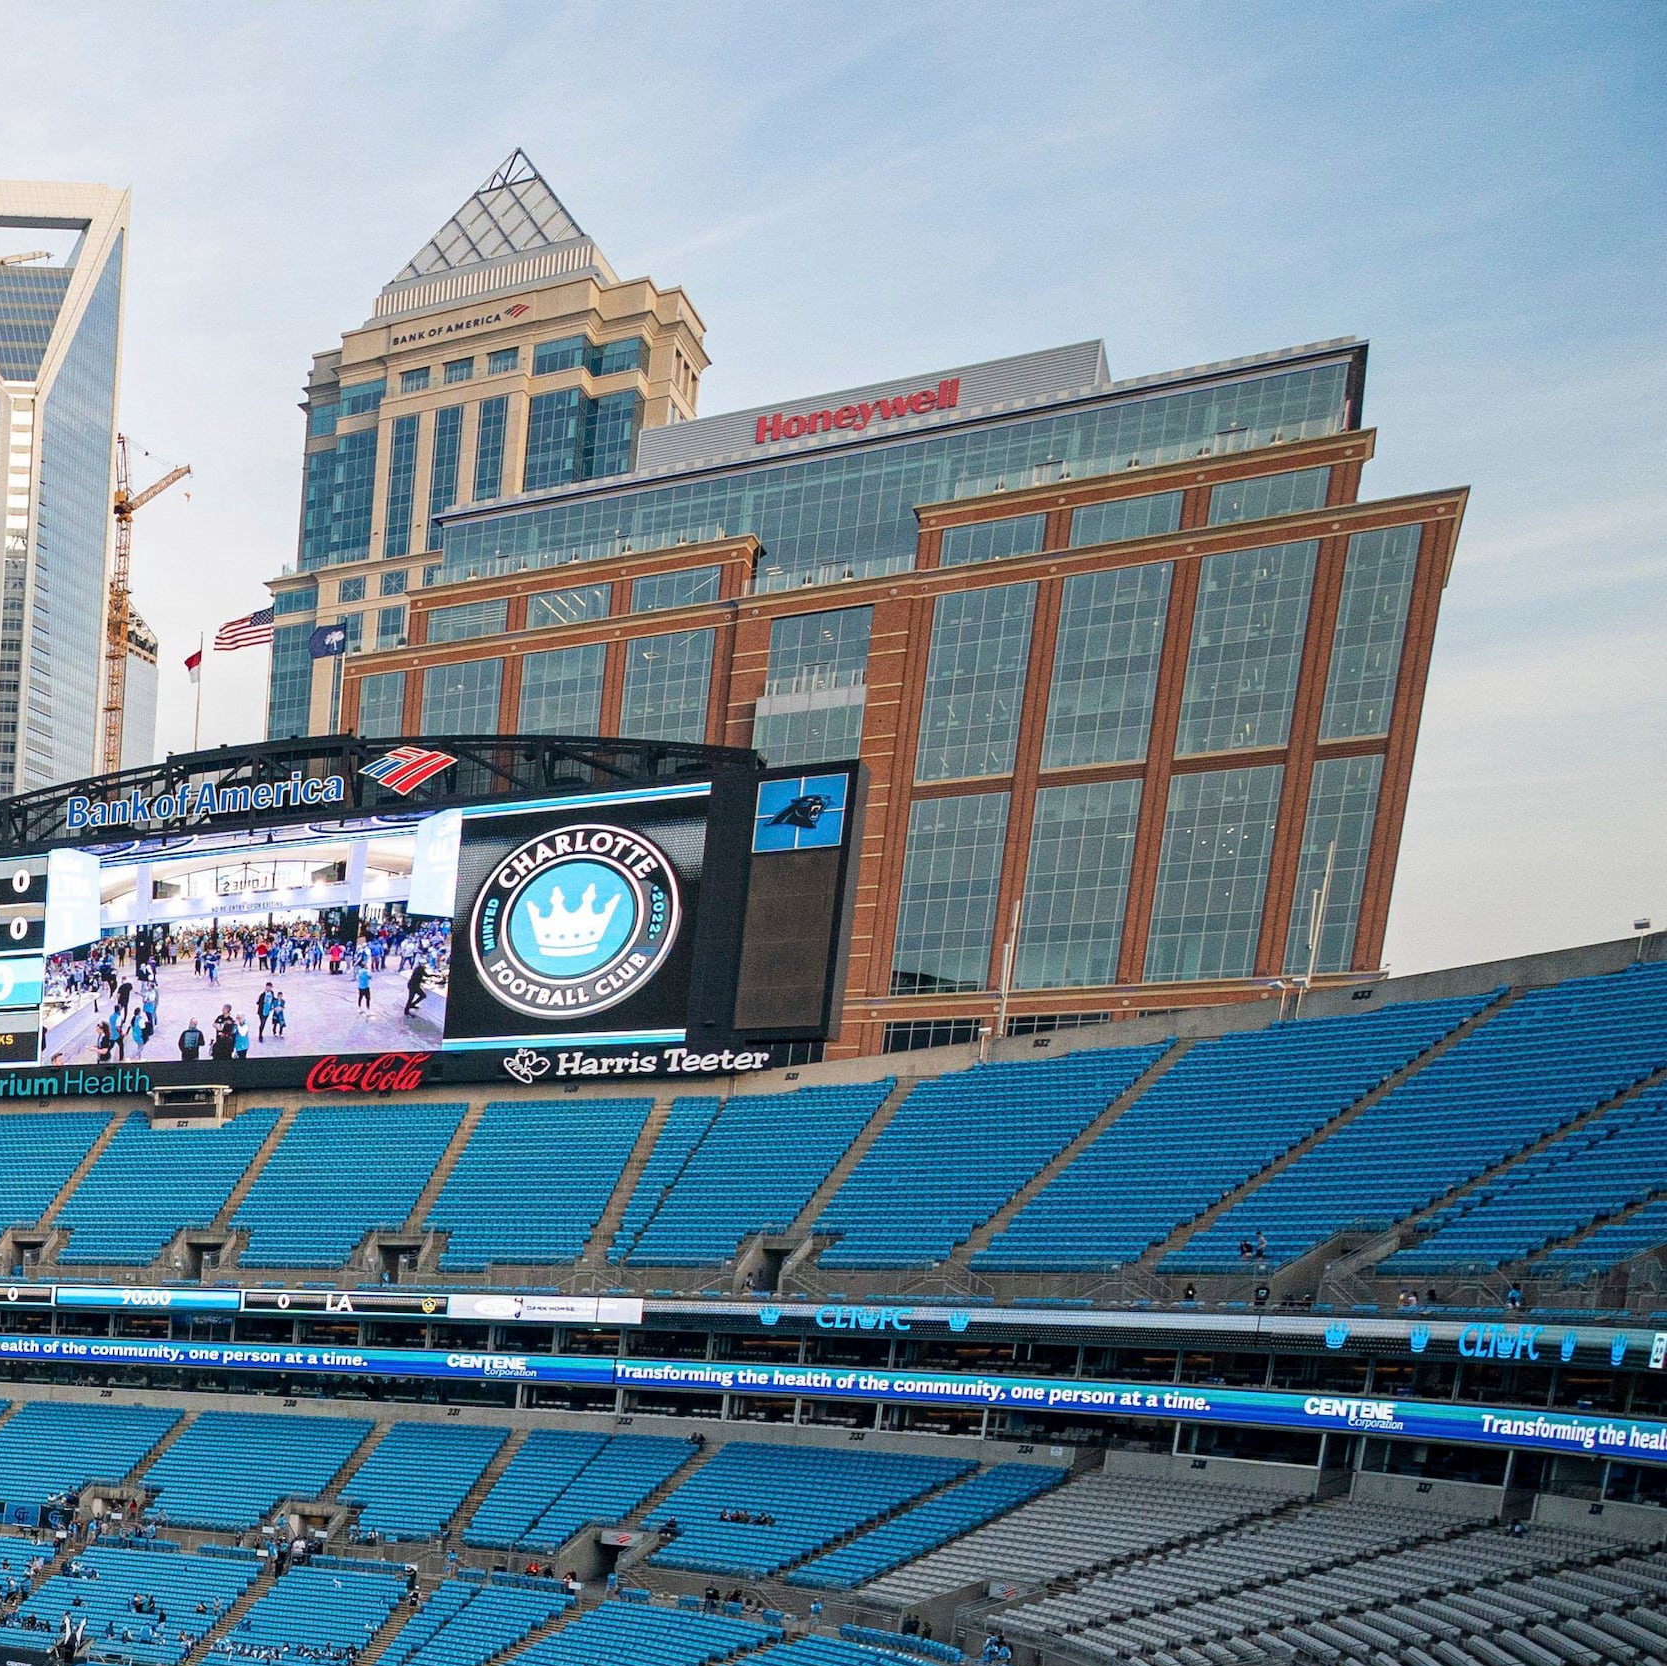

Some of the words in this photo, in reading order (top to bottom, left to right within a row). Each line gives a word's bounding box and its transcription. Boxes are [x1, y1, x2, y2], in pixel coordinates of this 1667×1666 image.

[393, 332, 425, 346] BANK
[428, 326, 444, 337] OF
[445, 314, 501, 334] AMERICA
[755, 378, 961, 444] Honeywell
[66, 789, 151, 829] Bank
[155, 783, 191, 820] of
[193, 770, 345, 815] America
[498, 832, 658, 888] CHARLOTTE
[12, 869, 30, 893] 0
[10, 916, 27, 940] 0
[482, 898, 499, 951] MINTED
[490, 960, 590, 1006] FOOTBALL
[594, 952, 647, 996] CLUB
[556, 1051, 657, 1076] Harris
[664, 1048, 769, 1072] Teeter
[63, 1067, 151, 1093] Health
[7, 1285, 19, 1302] 0
[121, 1289, 172, 1306] 90:00
[277, 1294, 290, 1309] 0
[325, 1294, 354, 1312] LA
[43, 1340, 60, 1353] of
[62, 1341, 87, 1355] the
[91, 1343, 184, 1362] community,
[189, 1348, 219, 1361] one
[223, 1350, 281, 1366] person
[285, 1351, 302, 1364] at
[307, 1353, 317, 1364] a
[322, 1352, 368, 1366] time.
[447, 1354, 528, 1370] CENTENE
[483, 1366, 537, 1377] Corporation
[615, 1363, 733, 1387] Transforming
[737, 1367, 769, 1385] the
[773, 1370, 831, 1389] health
[836, 1373, 856, 1389] of
[859, 1374, 890, 1391] the
[893, 1378, 1006, 1401] community,
[1011, 1385, 1044, 1401] one
[1049, 1389, 1115, 1407] person
[1120, 1391, 1141, 1406] at
[1146, 1394, 1158, 1407] a
[1163, 1392, 1211, 1411] time.
[1304, 1397, 1395, 1419] CENTENE
[1348, 1416, 1404, 1431] Corporation
[1481, 1414, 1597, 1449] Transforming
[1599, 1422, 1626, 1444] the
[1017, 1445, 1034, 1454] 234
